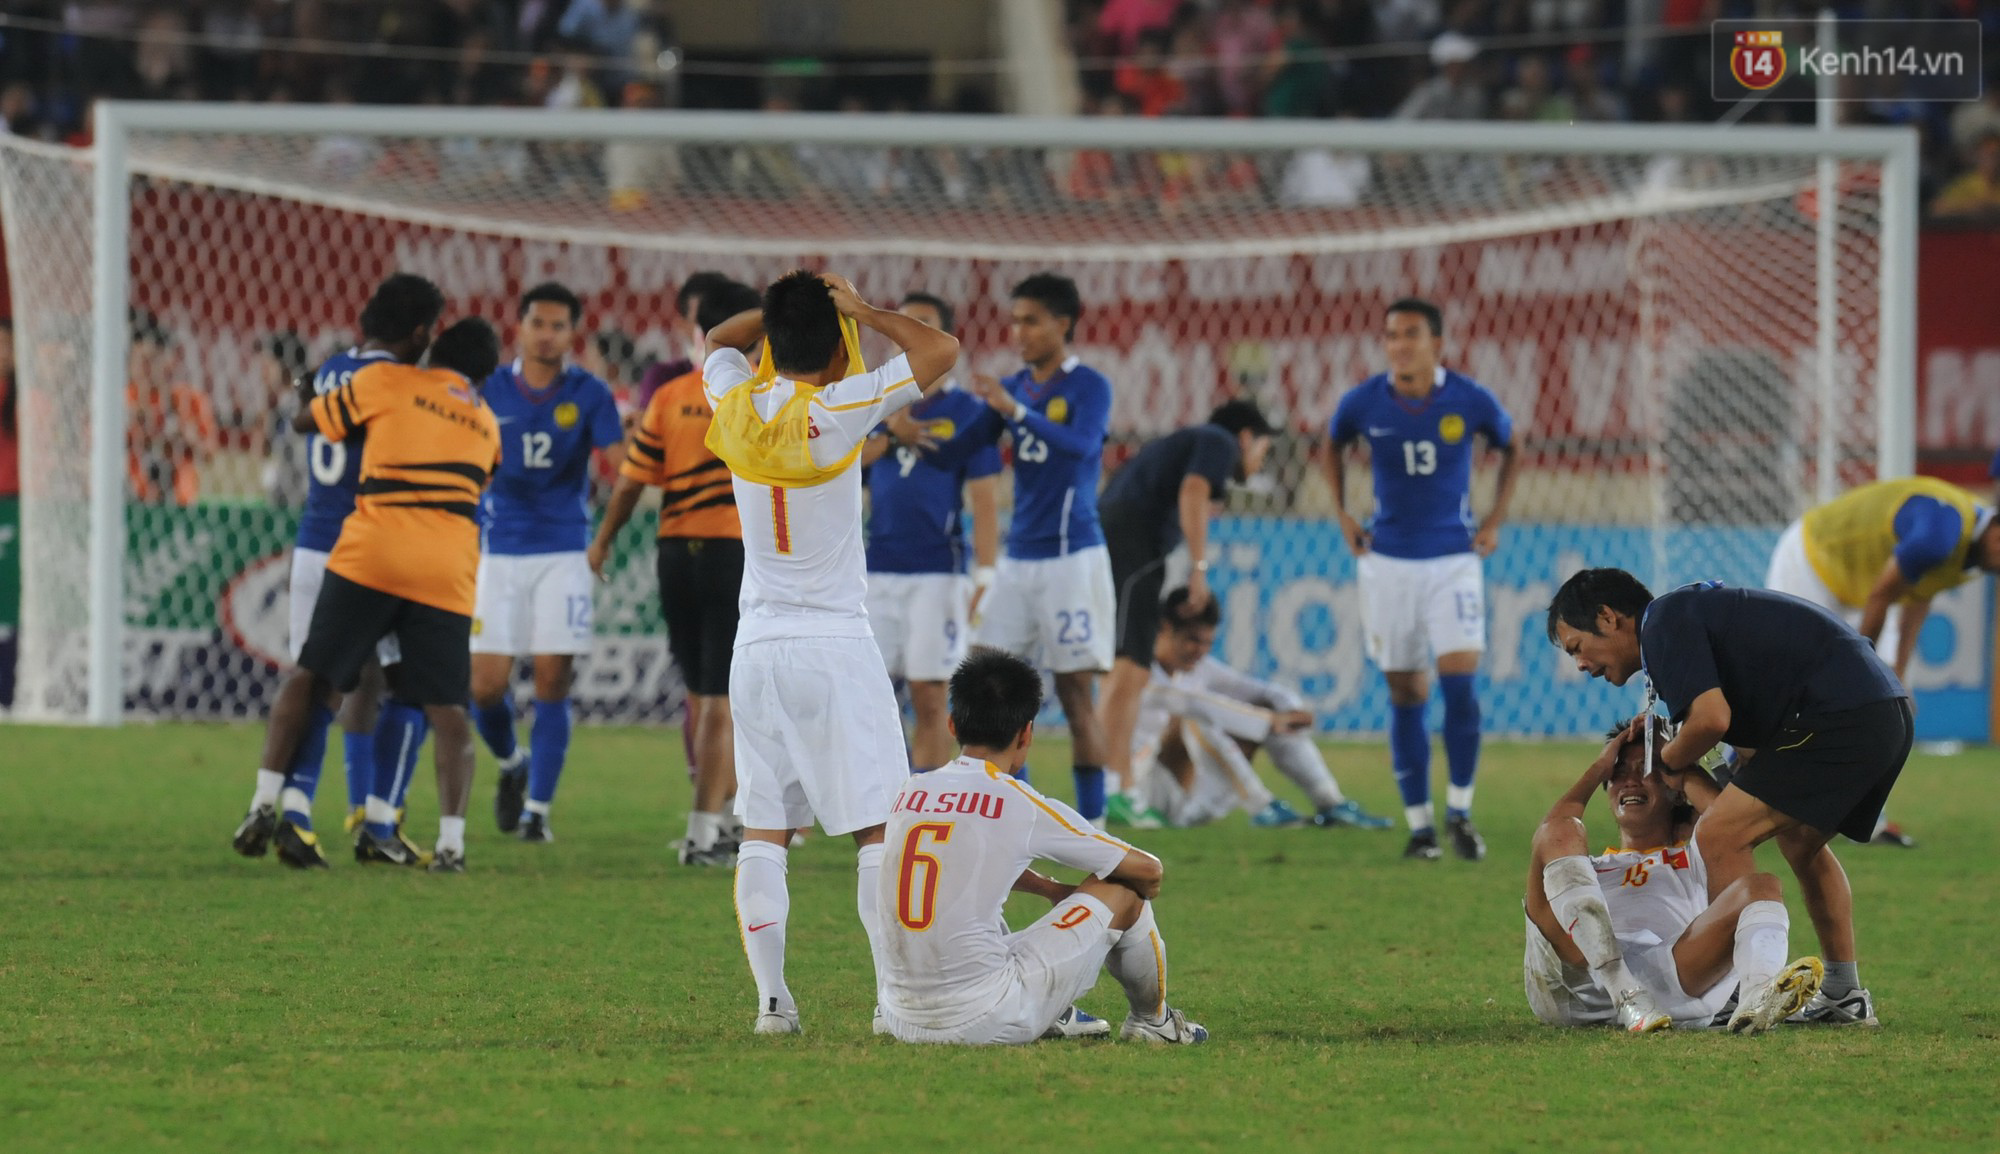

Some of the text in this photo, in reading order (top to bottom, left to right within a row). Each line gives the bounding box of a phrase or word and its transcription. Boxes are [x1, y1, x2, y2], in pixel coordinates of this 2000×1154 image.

[413, 393, 491, 440] MALAYSIA
[521, 431, 552, 468] 12
[896, 446, 917, 478] 9
[1402, 440, 1437, 476] 13
[770, 484, 792, 556] 1
[566, 595, 591, 628] 12
[1454, 590, 1480, 623] 13
[943, 618, 959, 651] 9
[1056, 609, 1092, 645] 23
[898, 822, 955, 932] 6
[1621, 859, 1654, 888] 15
